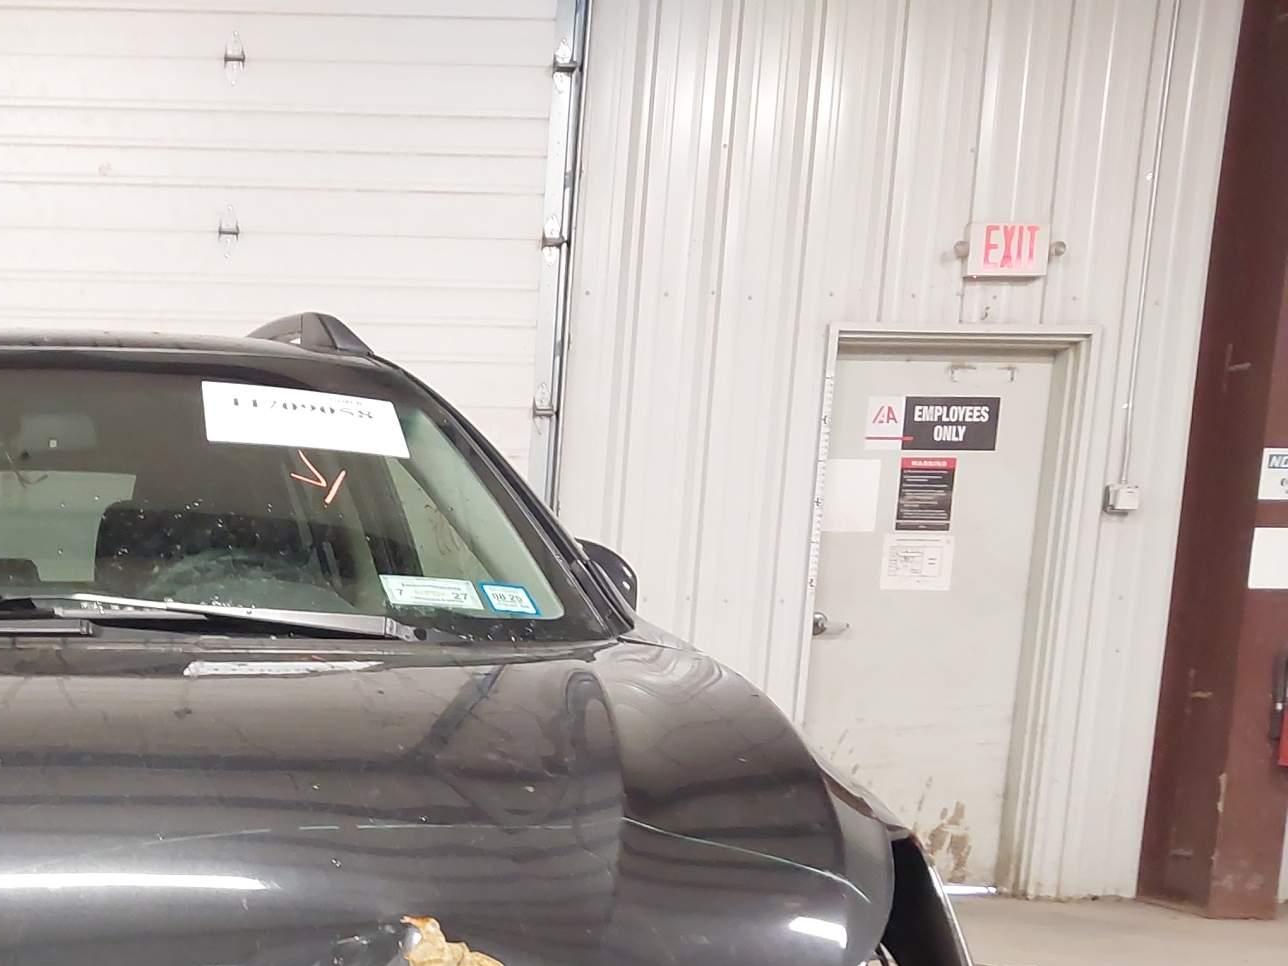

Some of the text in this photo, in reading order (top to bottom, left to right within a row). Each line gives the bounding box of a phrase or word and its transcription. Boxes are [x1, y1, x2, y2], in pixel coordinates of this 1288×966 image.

[983, 224, 1040, 268] EXIT
[913, 405, 990, 423] EMPLOYEES
[933, 424, 967, 442] ONLY
